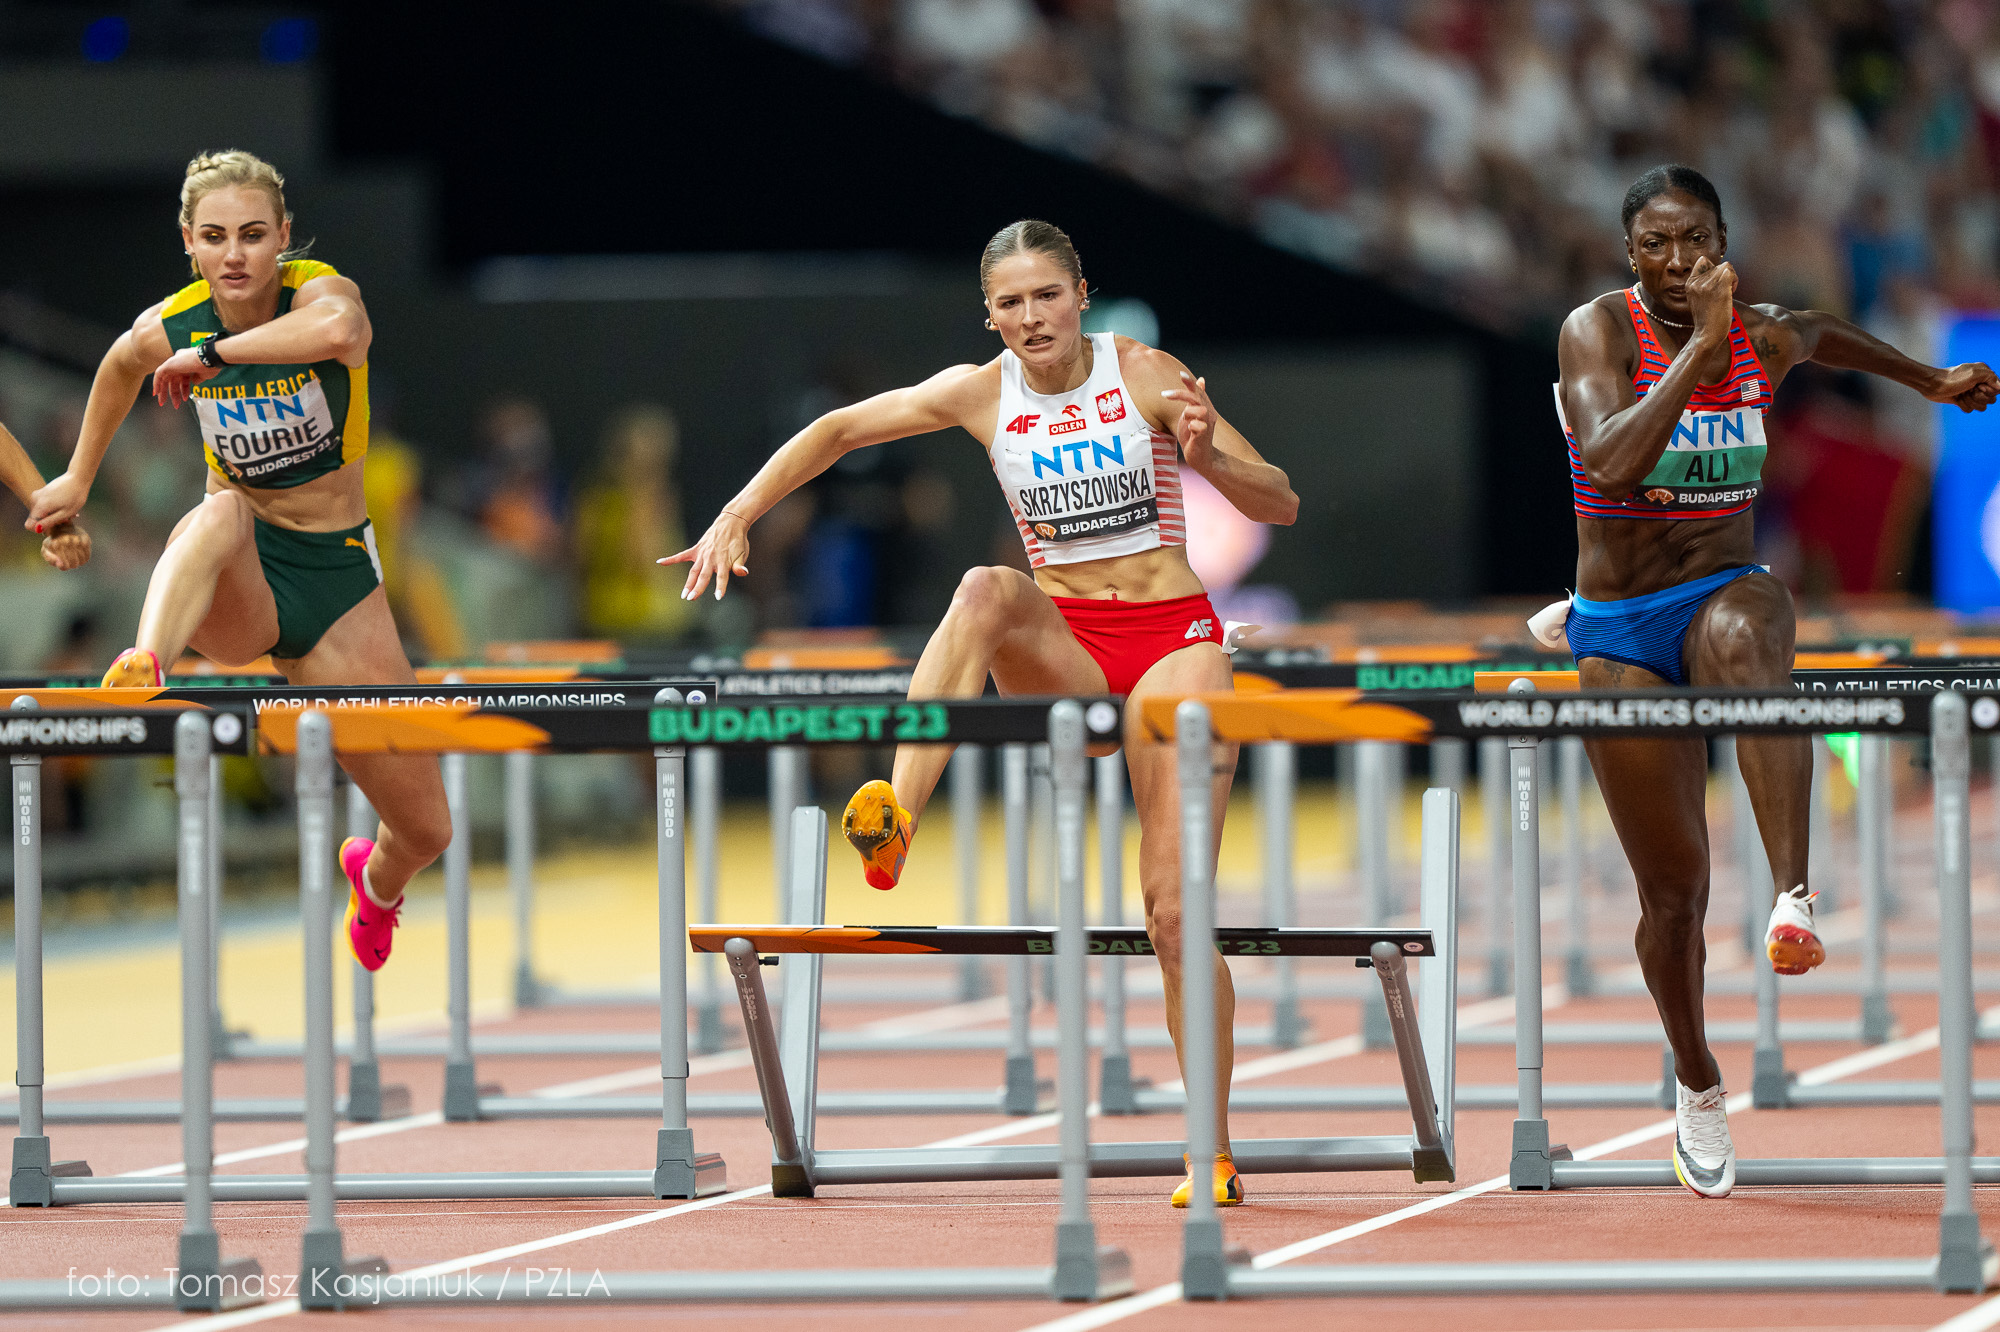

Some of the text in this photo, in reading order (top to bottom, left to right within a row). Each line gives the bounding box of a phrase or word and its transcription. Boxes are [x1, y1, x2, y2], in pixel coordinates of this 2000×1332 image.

[216, 395, 305, 428] NTN
[1050, 420, 1085, 434] ORLEN
[1670, 412, 1745, 448] NTN
[214, 417, 321, 459] FOURIE
[246, 438, 332, 477] BUDAPEST 23
[1032, 435, 1125, 480] NTN
[1684, 453, 1729, 483] ALI
[1019, 468, 1151, 517] SKRZYSZOWSKA
[1679, 488, 1758, 504] BUDAPEST 23
[1060, 507, 1149, 535] BUDAPEST 23
[648, 704, 950, 743] BUDAPEST 23
[1457, 698, 1905, 727] WORLD ATHLETICS CHAMPIONSHIPS
[19, 795, 32, 846] MONDO
[662, 787, 676, 838] MONDO
[1518, 780, 1530, 831] MONDO
[1236, 940, 1281, 954] 23
